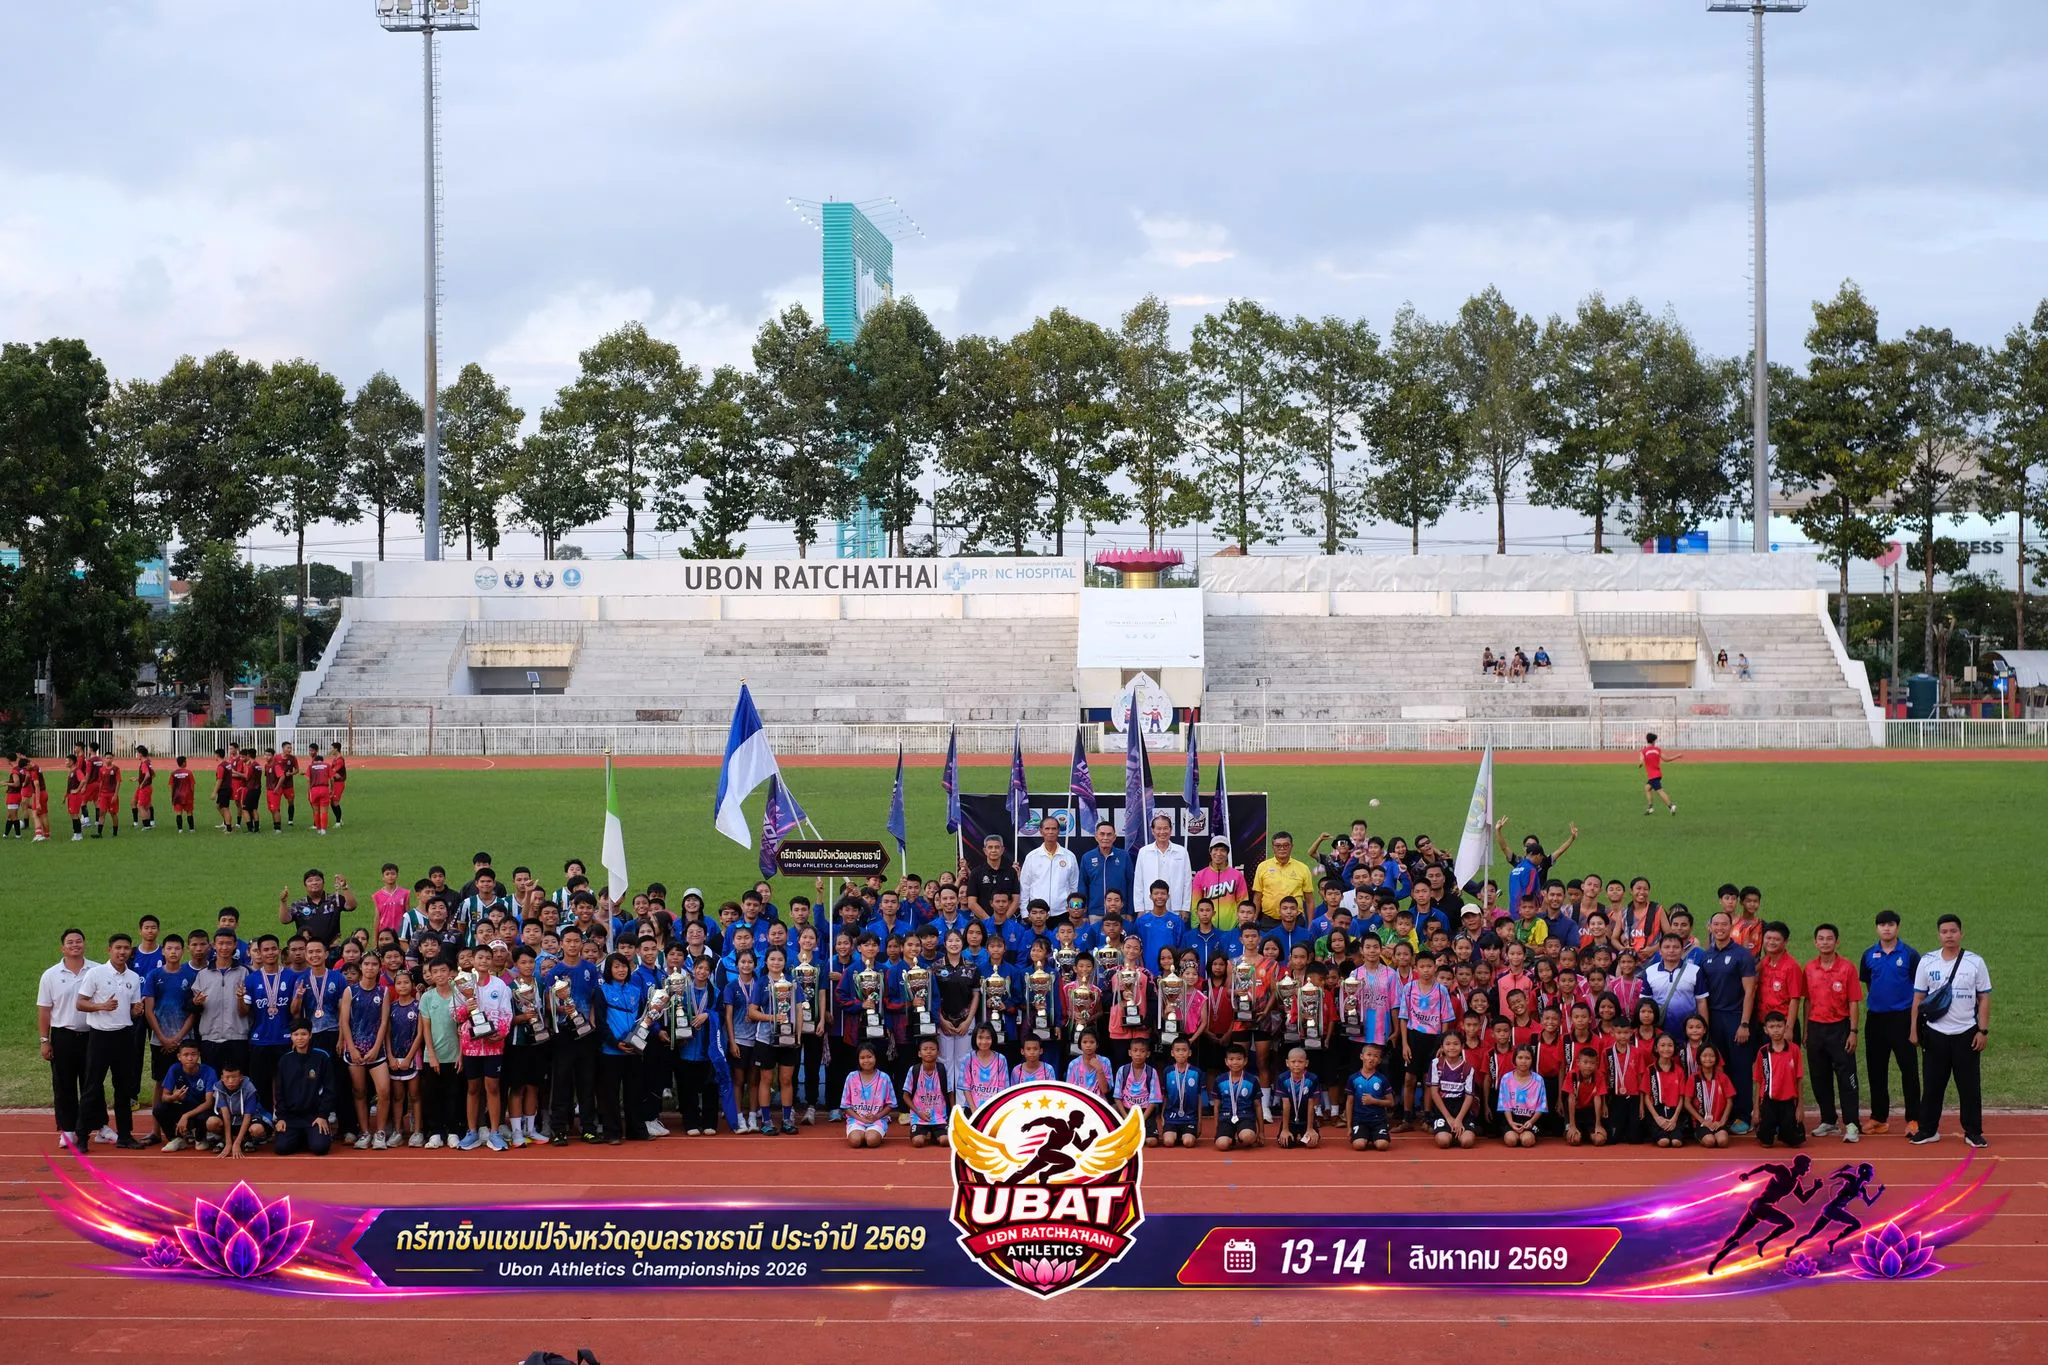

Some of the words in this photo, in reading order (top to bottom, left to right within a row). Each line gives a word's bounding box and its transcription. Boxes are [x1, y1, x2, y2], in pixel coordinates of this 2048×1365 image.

[685, 566, 762, 589] UBON
[972, 568, 1012, 579] PRNC
[1016, 568, 1076, 579] HOSPITAL
